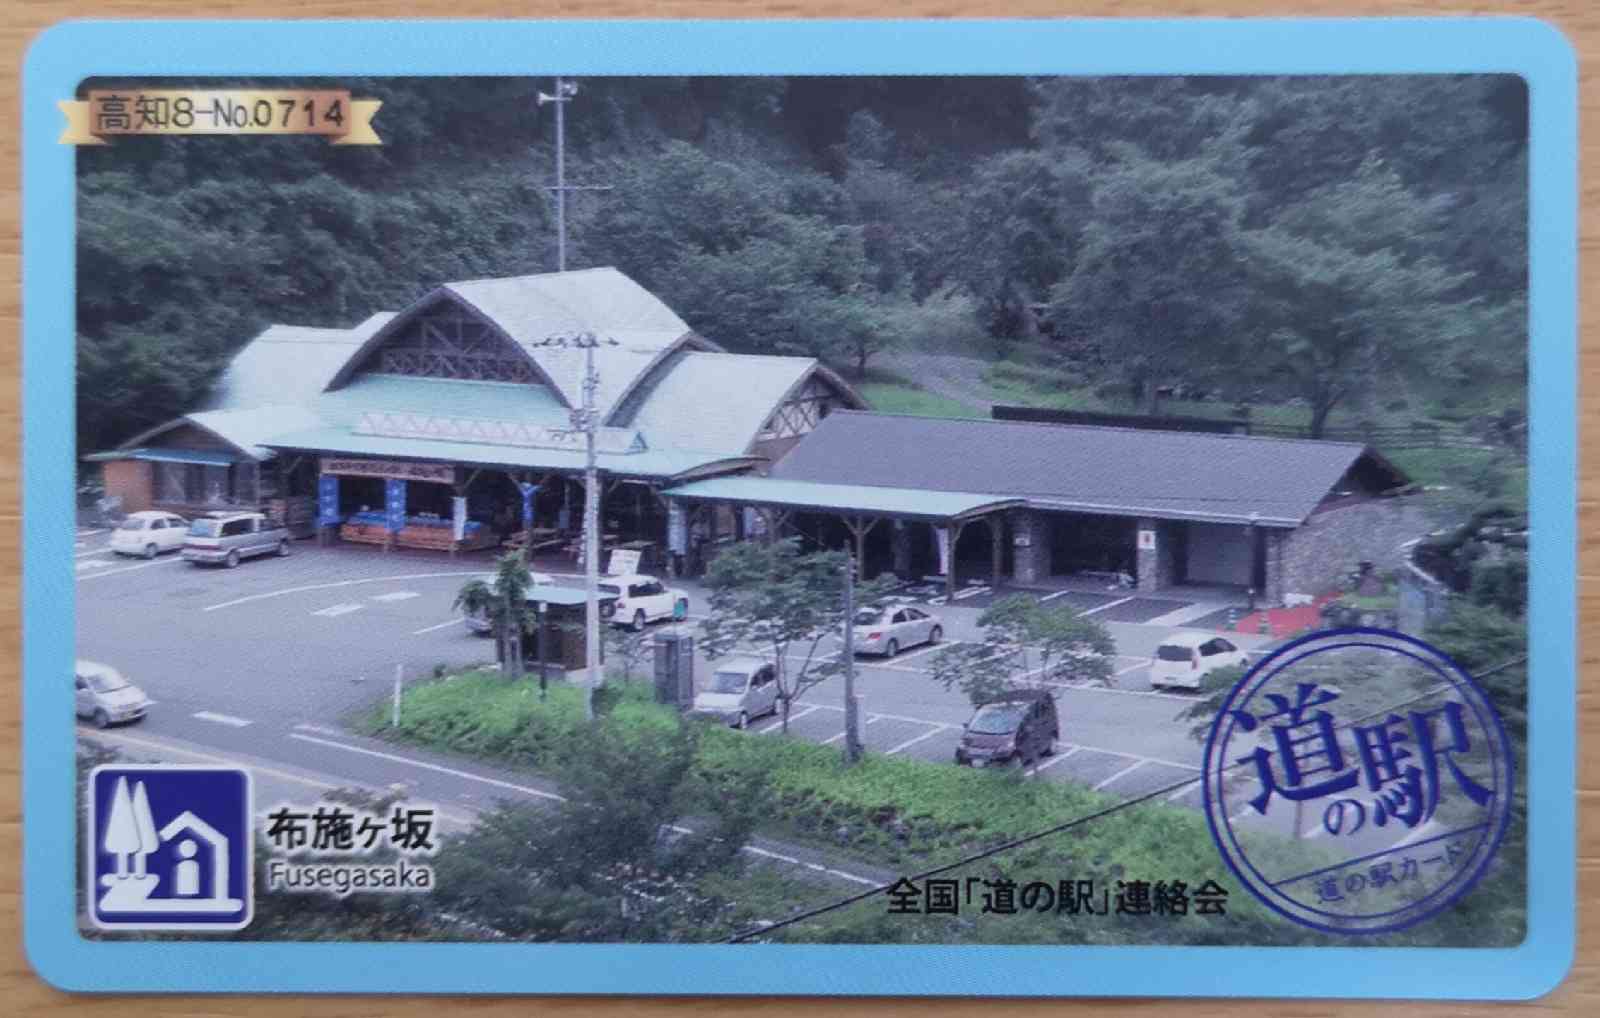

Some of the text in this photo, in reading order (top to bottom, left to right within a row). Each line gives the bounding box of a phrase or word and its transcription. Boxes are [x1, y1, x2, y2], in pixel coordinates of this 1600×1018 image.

[267, 807, 434, 850] 布施ヶ坂
[270, 861, 430, 893] Fusegasaka
[886, 877, 1229, 916] 全国「道の駅」連絡会
